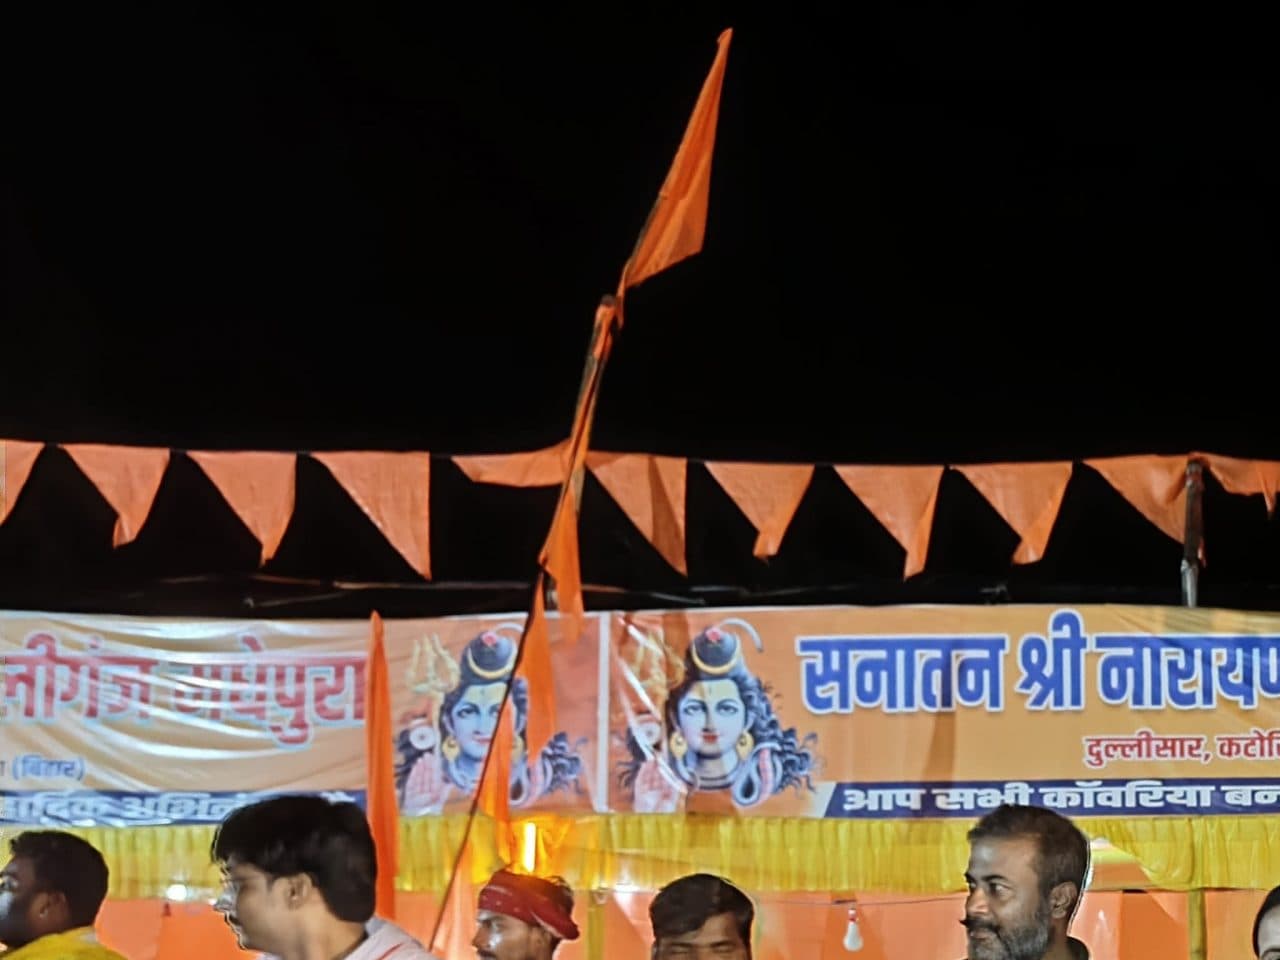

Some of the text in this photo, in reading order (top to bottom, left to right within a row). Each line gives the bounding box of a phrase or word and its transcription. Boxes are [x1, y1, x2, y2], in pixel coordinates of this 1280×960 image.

[797, 634, 1008, 713] सनातन
[1016, 609, 1088, 711] श्री
[1084, 729, 1213, 768] दुल्लीसार,
[842, 787, 927, 811] आप
[931, 781, 1034, 810] सभी
